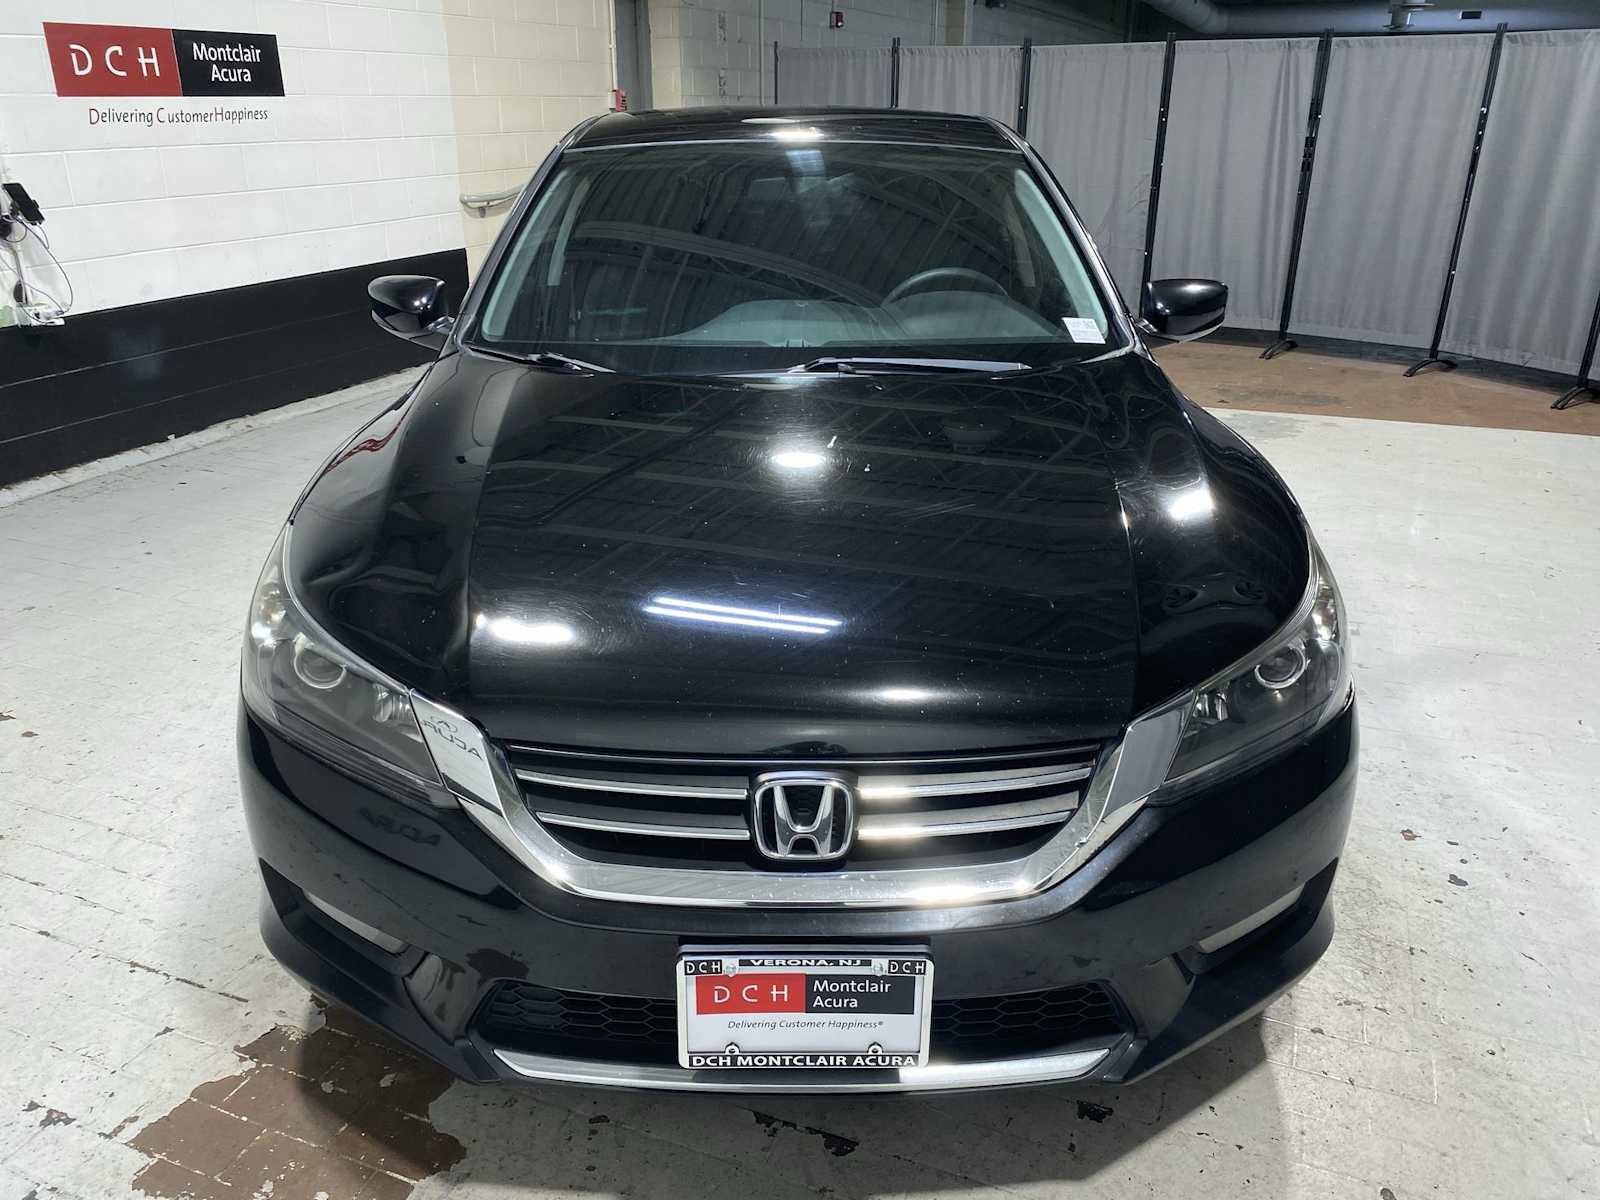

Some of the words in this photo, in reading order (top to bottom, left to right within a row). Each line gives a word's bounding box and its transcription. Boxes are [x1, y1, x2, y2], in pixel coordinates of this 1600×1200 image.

[193, 42, 261, 62] Montclair
[69, 44, 160, 77] DCH
[211, 63, 252, 82] Acura
[89, 107, 153, 127] Delivering
[686, 961, 721, 974] DCH
[750, 959, 834, 967] VERONA,
[839, 959, 862, 967] NJ
[889, 961, 925, 974] DCH
[813, 979, 892, 993] Montclair
[713, 984, 789, 1003] DCH
[813, 995, 858, 1008] Acura
[728, 1020, 777, 1030] Delivering
[779, 1020, 826, 1029] Customer
[692, 1055, 731, 1066] DCH
[736, 1055, 848, 1066] MONTCLAIR
[852, 1055, 916, 1066] ACURA
